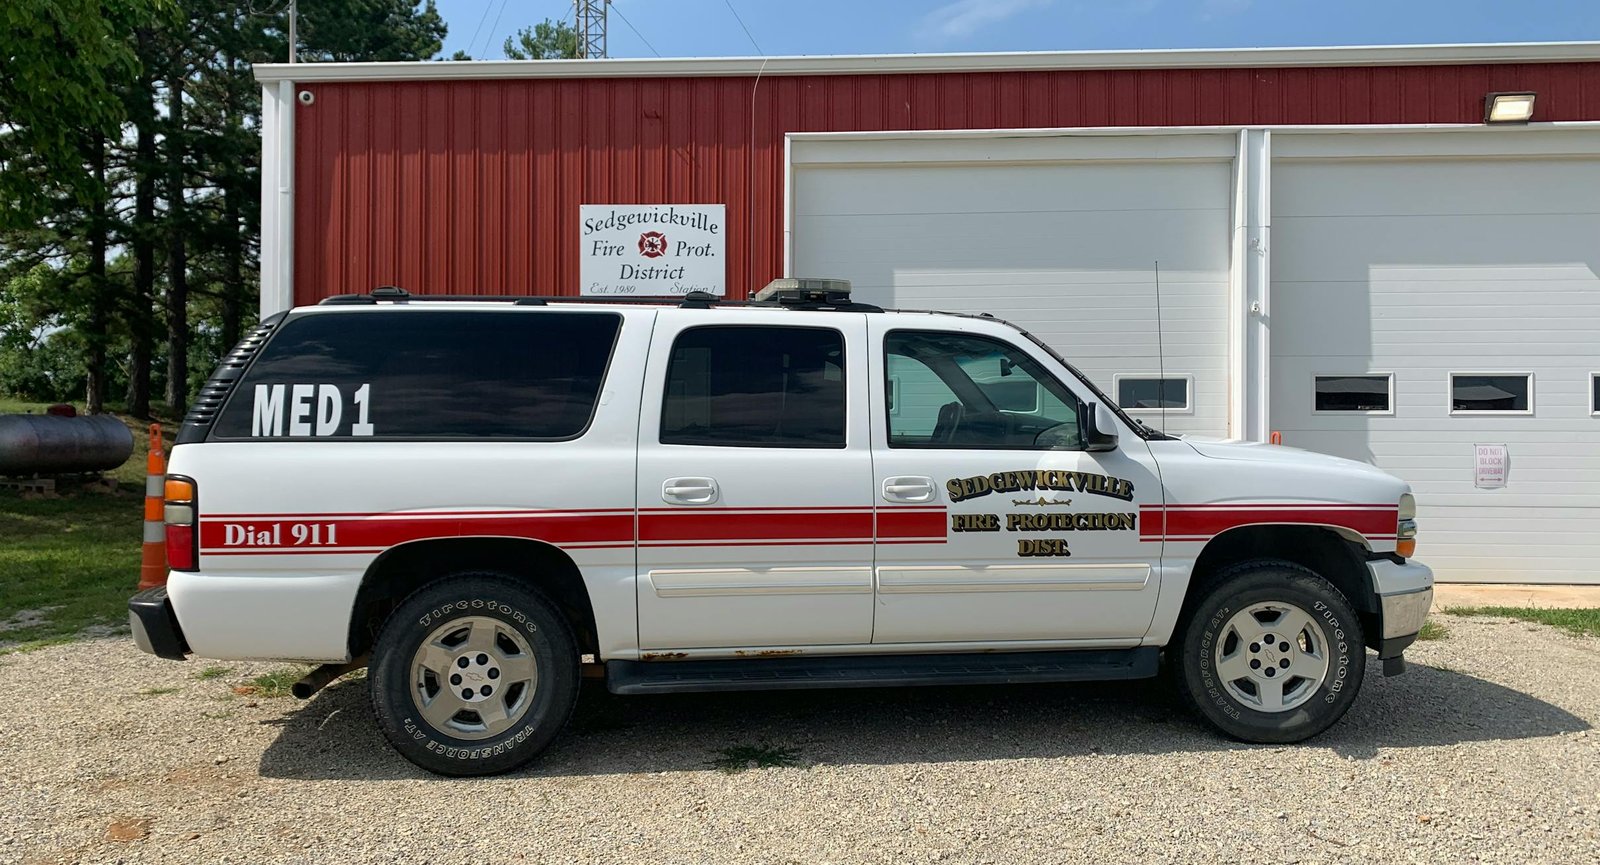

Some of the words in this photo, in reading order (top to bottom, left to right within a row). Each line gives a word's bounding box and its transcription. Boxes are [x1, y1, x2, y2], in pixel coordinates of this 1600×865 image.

[584, 207, 719, 235] Sedgewickville
[591, 240, 625, 256] Fire
[675, 240, 715, 257] Prot.
[619, 264, 685, 280] District
[590, 282, 609, 294] Est.
[613, 285, 636, 294] 1980
[252, 384, 342, 437] MED
[352, 383, 374, 436] 1
[946, 469, 1135, 502] SEDGEWICKVILLE
[224, 523, 281, 546] Dial
[291, 523, 338, 545] 911
[952, 513, 1001, 532] FIRE
[1006, 512, 1137, 532] PROTECTION
[1017, 539, 1072, 557] DIST.
[419, 599, 538, 633] Firestone
[1313, 600, 1350, 704] Firestone
[1200, 630, 1241, 720] TRANSFORCE
[425, 725, 535, 760] TRANSFORCE
